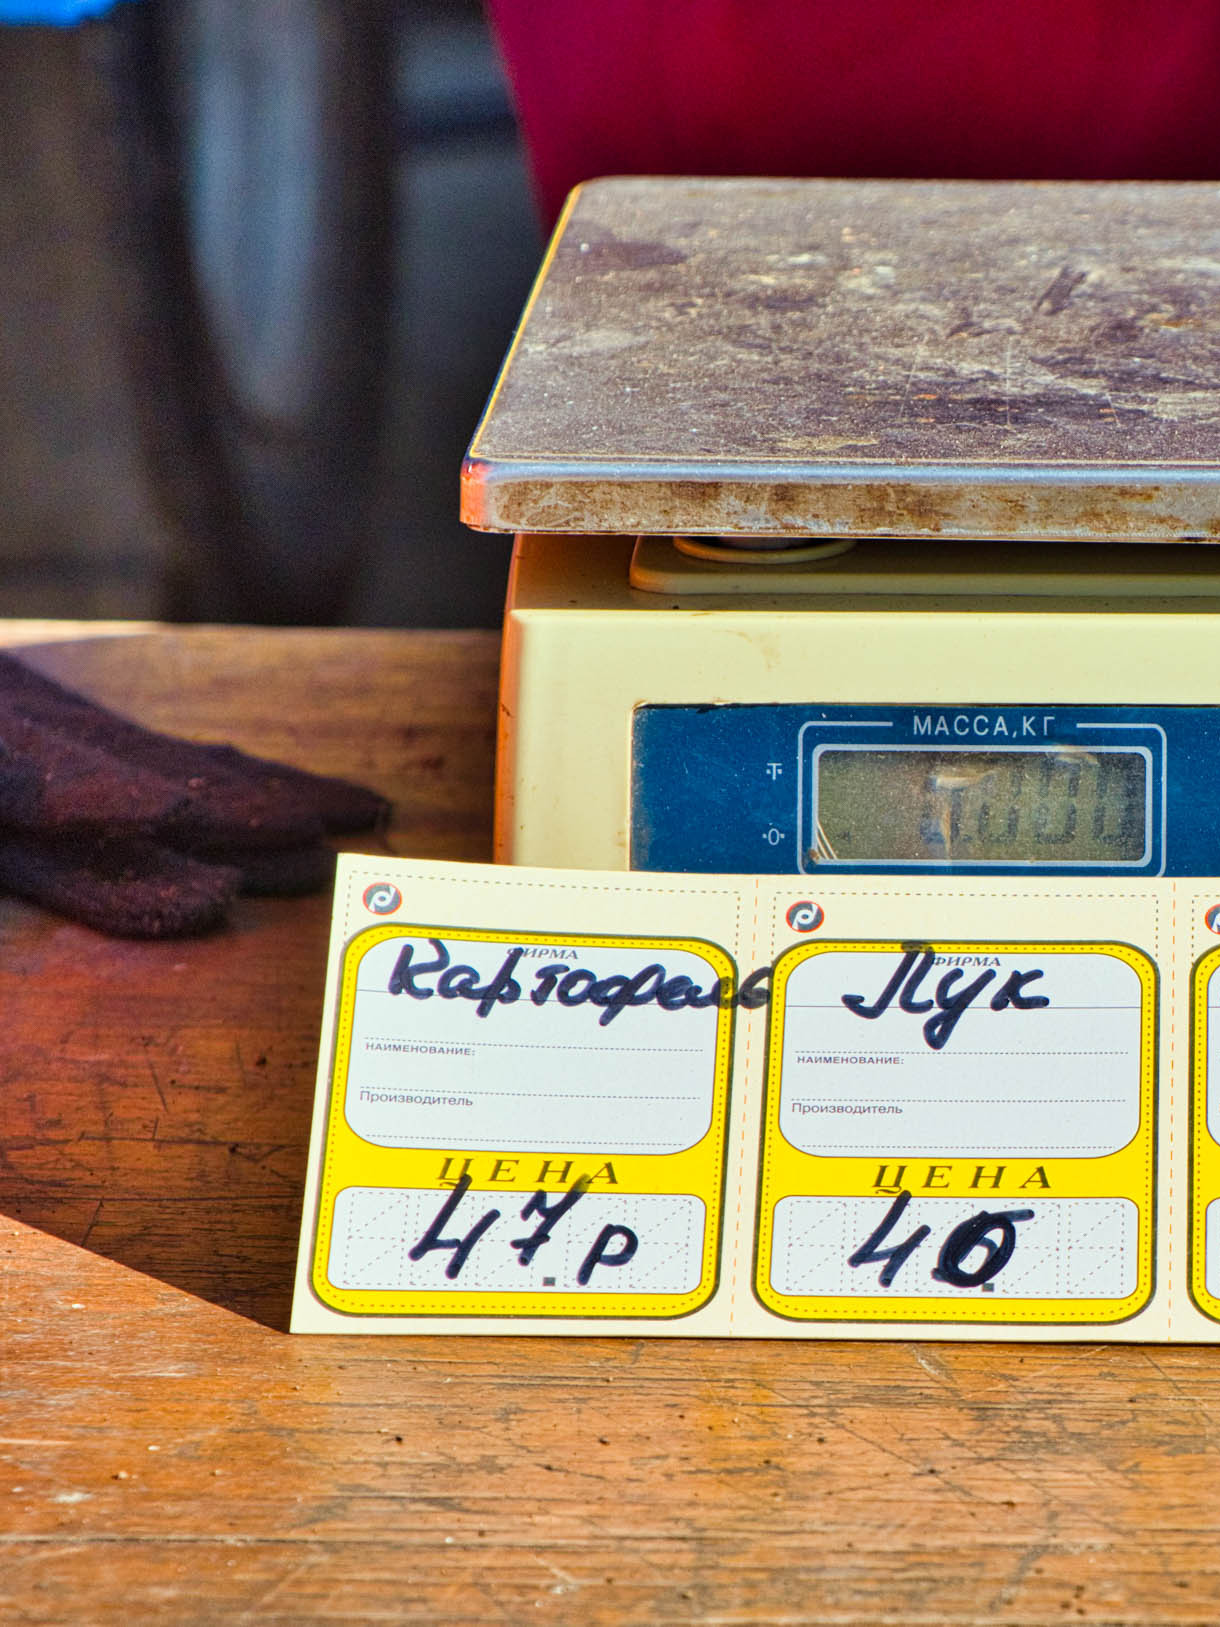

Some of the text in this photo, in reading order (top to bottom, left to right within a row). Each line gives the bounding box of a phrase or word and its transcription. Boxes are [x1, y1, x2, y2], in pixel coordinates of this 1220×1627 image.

[841, 941, 1050, 1050] Лук
[365, 1042, 476, 1056] НАИМЕНОВАНИЕ:
[797, 1056, 905, 1066] НАИМЕНОВАНИЕ:
[360, 1091, 473, 1107] Производитель
[792, 1102, 903, 1115] Производитель
[437, 1157, 619, 1188] ЦЕНА
[871, 1165, 1051, 1194] ЦЕНА
